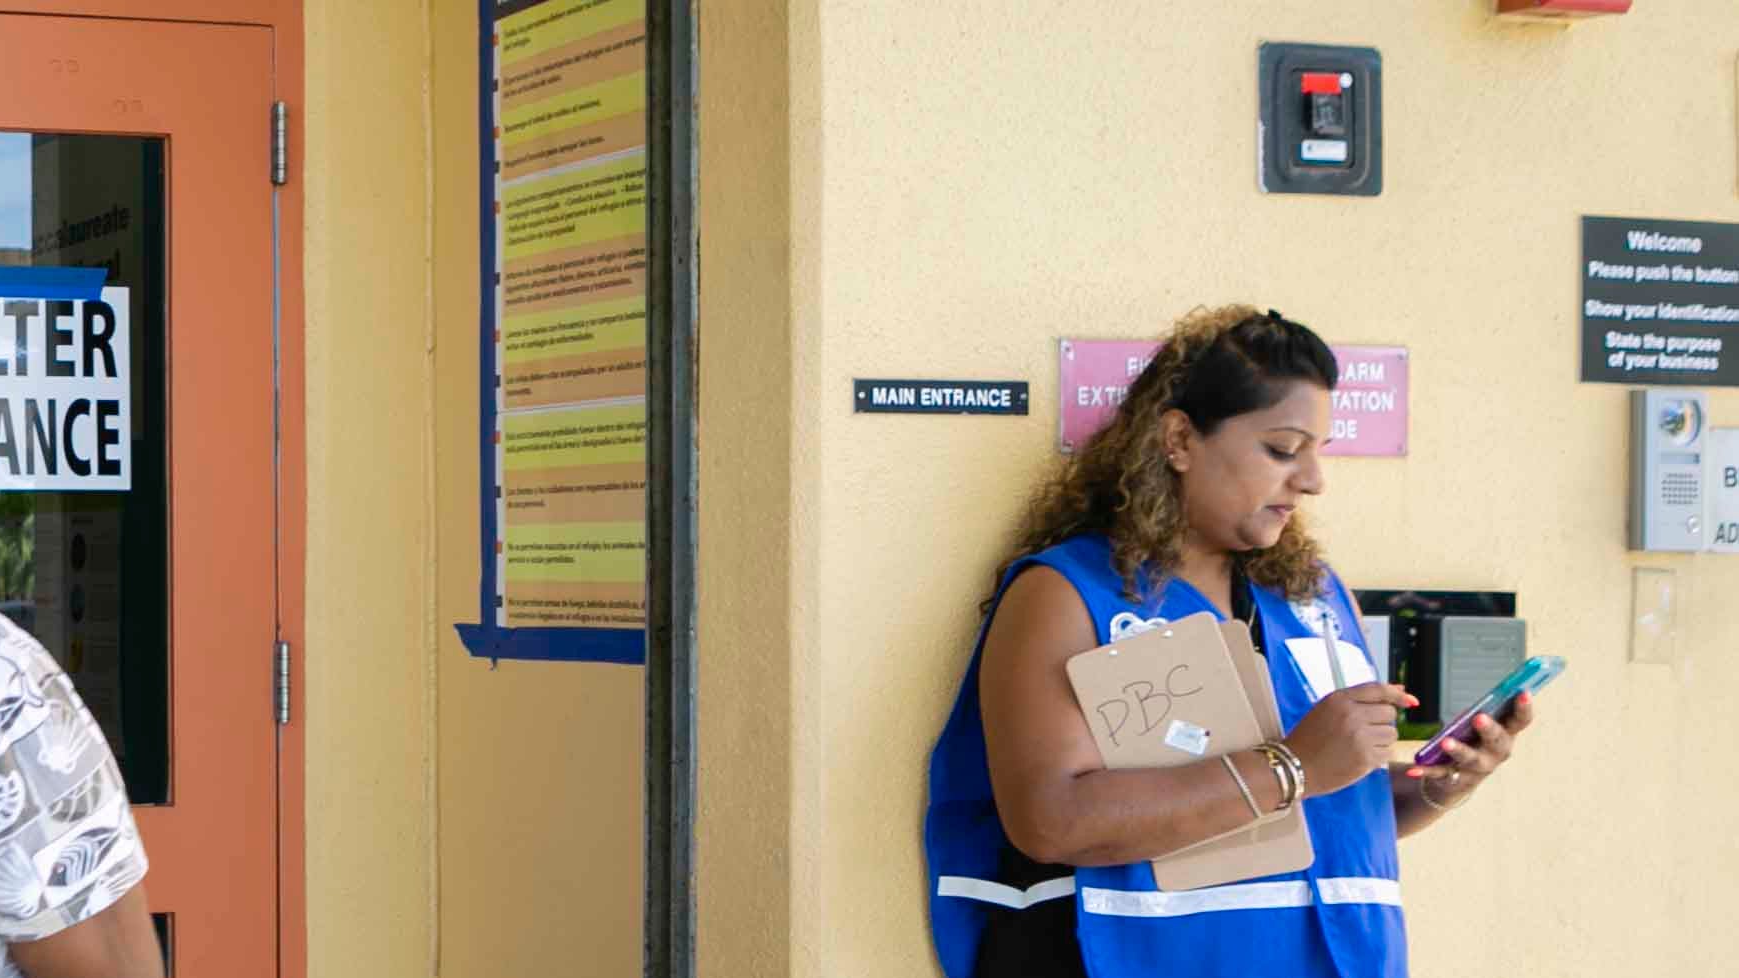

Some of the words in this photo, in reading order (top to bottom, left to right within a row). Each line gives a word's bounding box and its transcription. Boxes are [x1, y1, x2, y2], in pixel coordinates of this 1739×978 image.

[1627, 231, 1702, 253] Welcome
[1589, 260, 1634, 279] Please
[1635, 265, 1669, 282] push
[1672, 265, 1694, 282] the
[1695, 267, 1739, 283] button
[1585, 300, 1624, 317] Show
[1624, 304, 1657, 321] your
[1605, 331, 1642, 348] State
[1643, 333, 1665, 349] the
[1667, 337, 1722, 353] purpose
[1608, 351, 1625, 367] of
[1625, 354, 1657, 371] your
[1658, 354, 1719, 371] business
[872, 387, 915, 405] MAIN
[920, 388, 1011, 407] ENTRANCE
[1331, 390, 1395, 412] TATION
[1096, 664, 1204, 747] PBC
